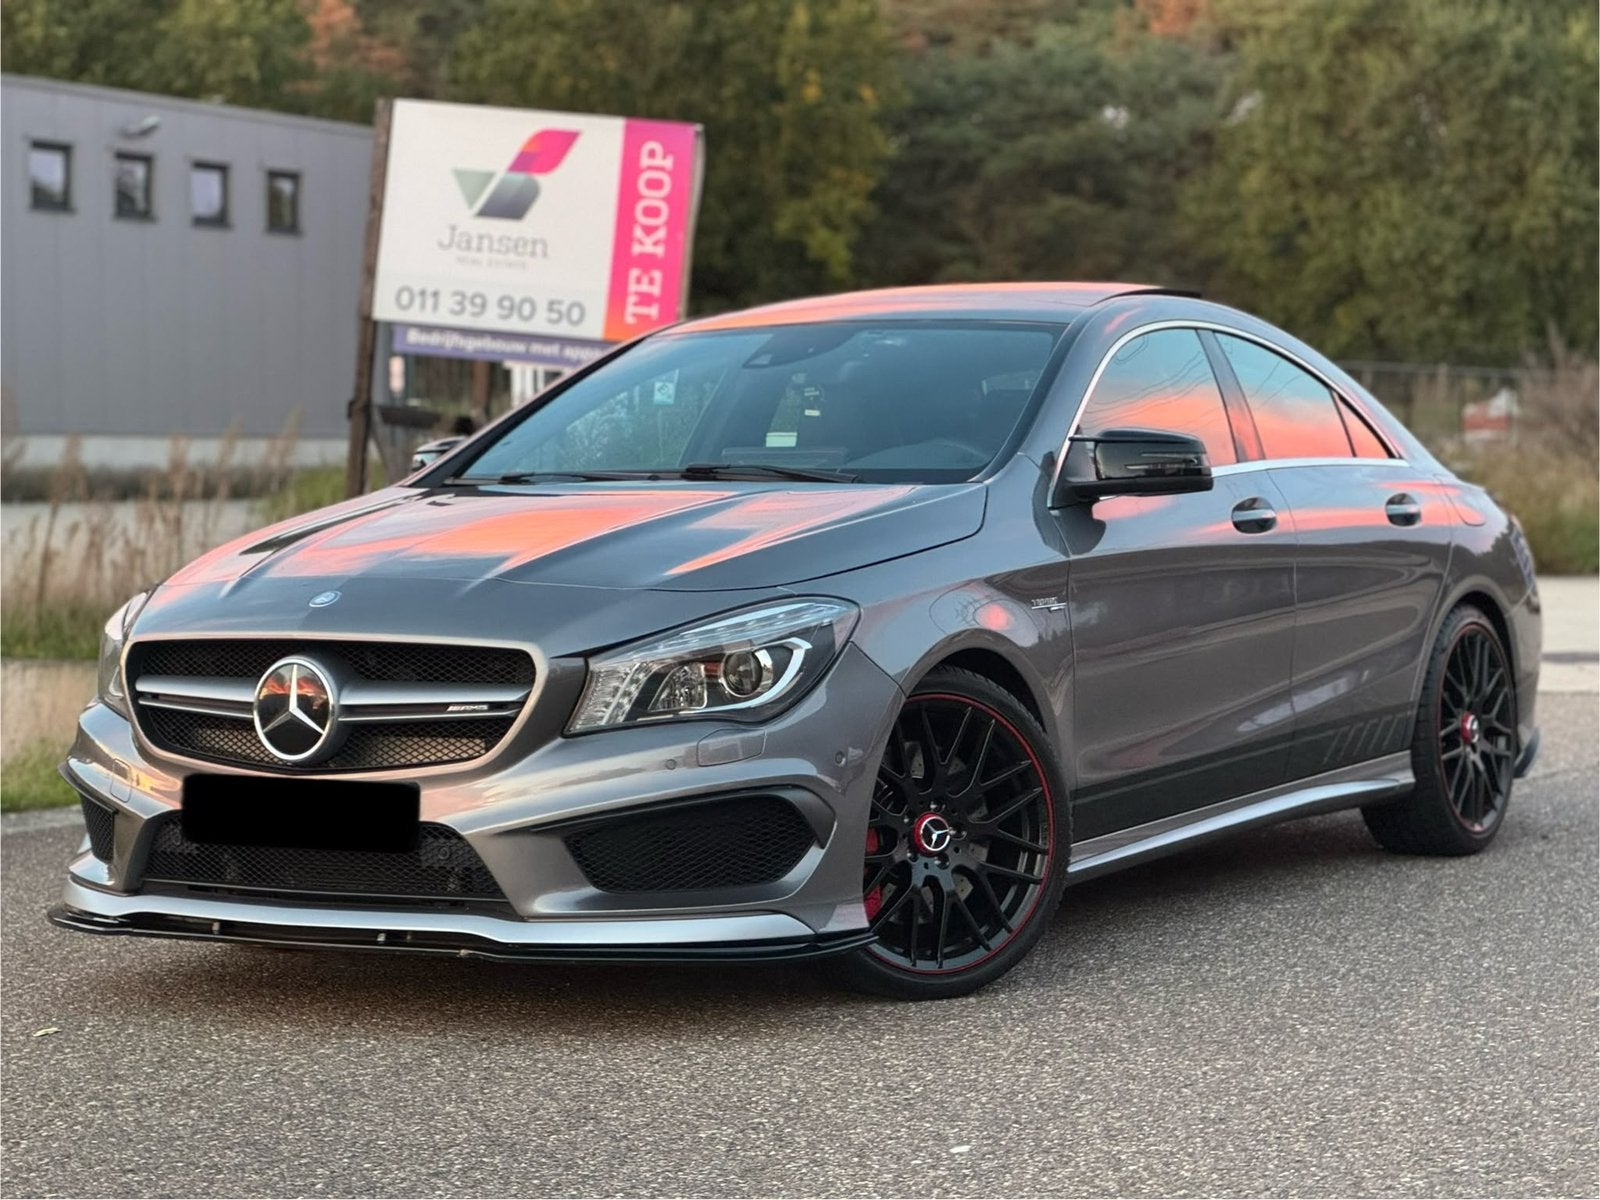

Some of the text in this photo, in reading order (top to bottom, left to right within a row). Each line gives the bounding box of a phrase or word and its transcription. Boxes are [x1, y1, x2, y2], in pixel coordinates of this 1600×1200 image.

[437, 224, 549, 259] Jansen
[624, 140, 674, 324] TE KOOP
[395, 286, 586, 326] 011 39 90 50
